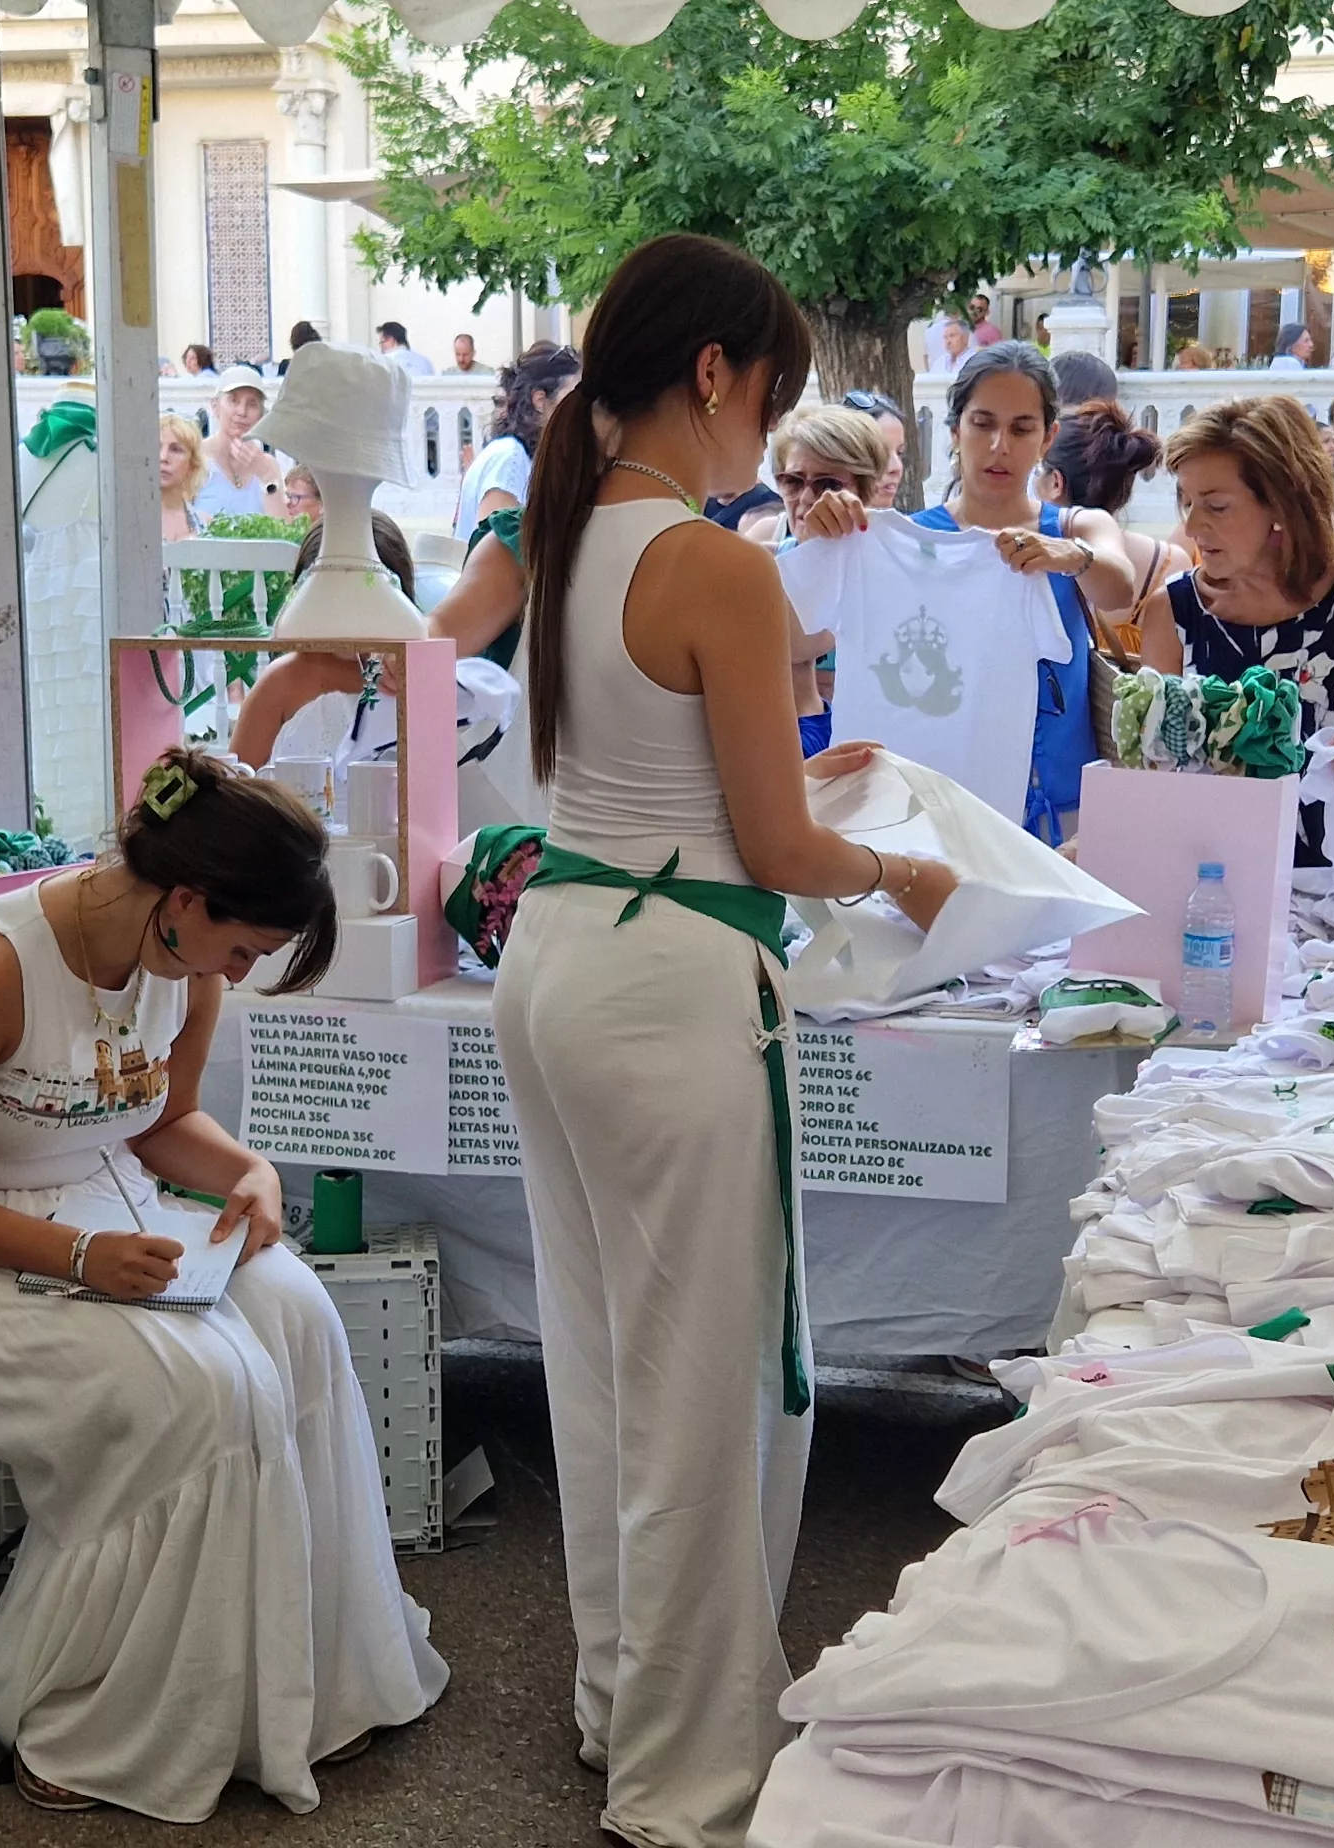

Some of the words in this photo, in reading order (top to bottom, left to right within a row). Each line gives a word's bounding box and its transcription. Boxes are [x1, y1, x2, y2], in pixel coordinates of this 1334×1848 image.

[249, 1013, 287, 1024] VELAS
[290, 1014, 324, 1026] VASO
[326, 1017, 347, 1027] 12€
[250, 1028, 281, 1040] VELA
[283, 1030, 340, 1043] PAJARITA
[342, 1033, 358, 1045] 5€
[830, 1035, 854, 1046] 14€
[251, 1044, 281, 1055] VELA
[283, 1045, 340, 1059] PAJARITA
[343, 1050, 376, 1062] VASO
[451, 1042, 459, 1052] 3
[461, 1042, 498, 1054] COLE
[484, 1060, 502, 1070] 10
[839, 1052, 856, 1064] 3€
[251, 1057, 297, 1072] LÁMINA
[299, 1062, 355, 1076] PEQUEÑA
[357, 1066, 392, 1080] 4,90€
[855, 1070, 873, 1082] 6€
[252, 1073, 297, 1088] LÁMINA
[299, 1078, 354, 1093] MEDIANA
[356, 1083, 388, 1096] 9,90€
[492, 1091, 509, 1102] 10
[837, 1086, 860, 1098] 14€
[252, 1091, 290, 1104] BOLSA
[292, 1094, 348, 1108] MOCHILA
[351, 1099, 371, 1110] 12€
[250, 1107, 306, 1121] MOCHILA
[308, 1111, 331, 1123] 35€
[478, 1107, 501, 1118] 10€
[838, 1102, 855, 1114] 8€
[249, 1123, 288, 1136] BOLSA
[291, 1126, 350, 1141] REDONDA
[352, 1131, 374, 1143] 35€
[492, 1123, 510, 1134] HU
[856, 1120, 879, 1133] 14€
[247, 1139, 272, 1150] TOP
[275, 1141, 308, 1154] CARA
[311, 1144, 370, 1158] REDONDA
[373, 1149, 396, 1161] 20€
[855, 1138, 966, 1156] PERSONALIZADA
[968, 1145, 993, 1157] 12€
[850, 1154, 885, 1167] LAZO
[888, 1156, 905, 1168] 8€
[838, 1170, 895, 1185] GRANDE
[897, 1174, 924, 1187] 20€
